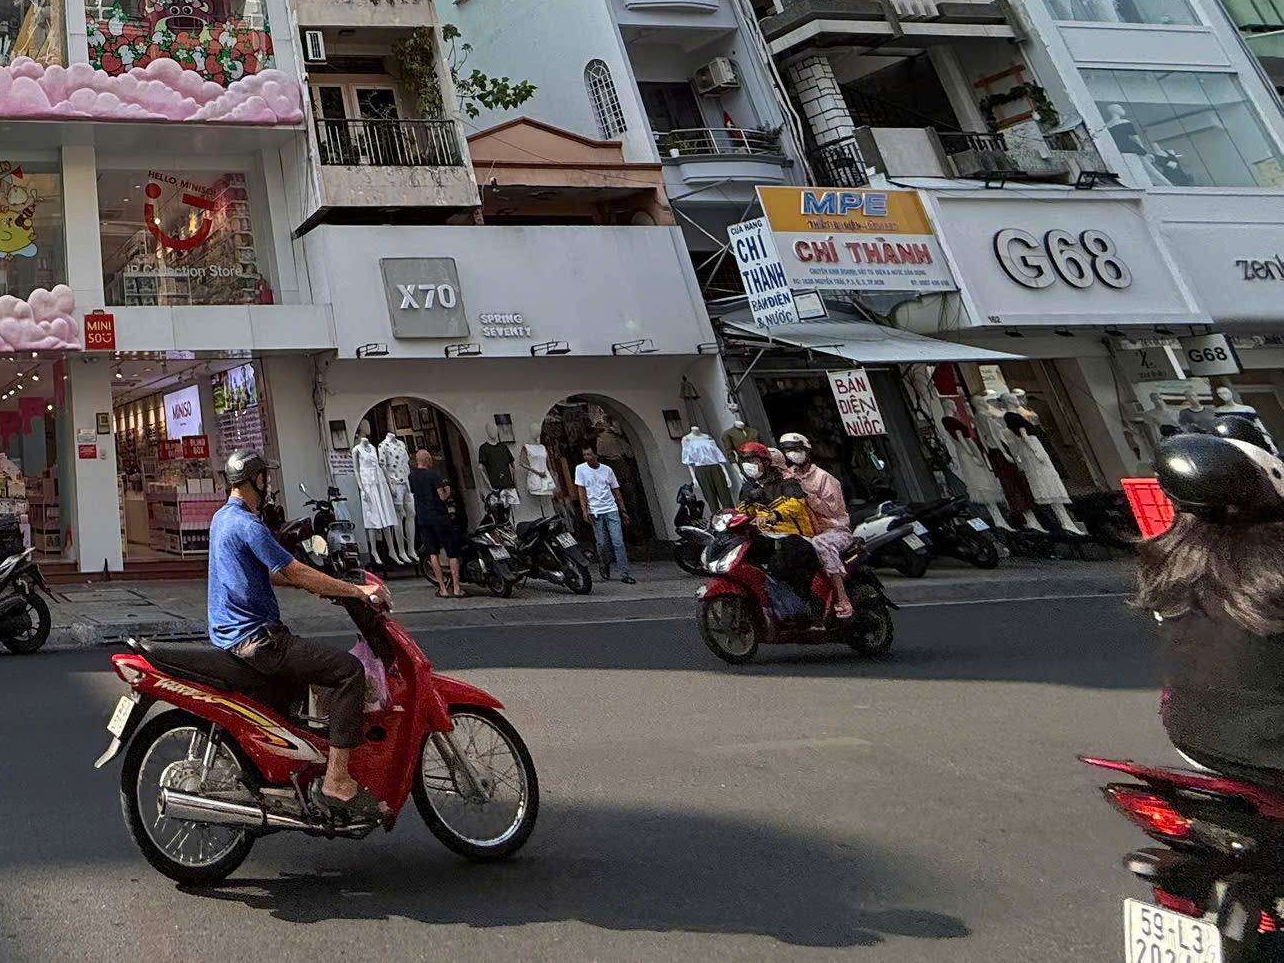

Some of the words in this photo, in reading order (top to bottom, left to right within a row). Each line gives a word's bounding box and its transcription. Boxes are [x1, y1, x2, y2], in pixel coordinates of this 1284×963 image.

[147, 170, 178, 187] HELLO,
[801, 190, 889, 216] MPE
[737, 228, 767, 263] CHÍ
[792, 236, 841, 264] CHÍ
[844, 237, 933, 264] THÀNH
[993, 228, 1133, 289] G68
[142, 264, 206, 277] Collection
[209, 265, 243, 277] Store
[742, 262, 788, 295] THÀNH
[397, 284, 457, 309] X70
[768, 291, 792, 308] ĐIỆN
[87, 321, 112, 331] MINI
[480, 313, 524, 324] SPRING
[482, 326, 532, 338] SEVENTY
[1188, 346, 1228, 363] G68
[834, 372, 867, 394] BÁN
[171, 400, 192, 421] MINISO
[846, 410, 883, 435] NƯỚC
